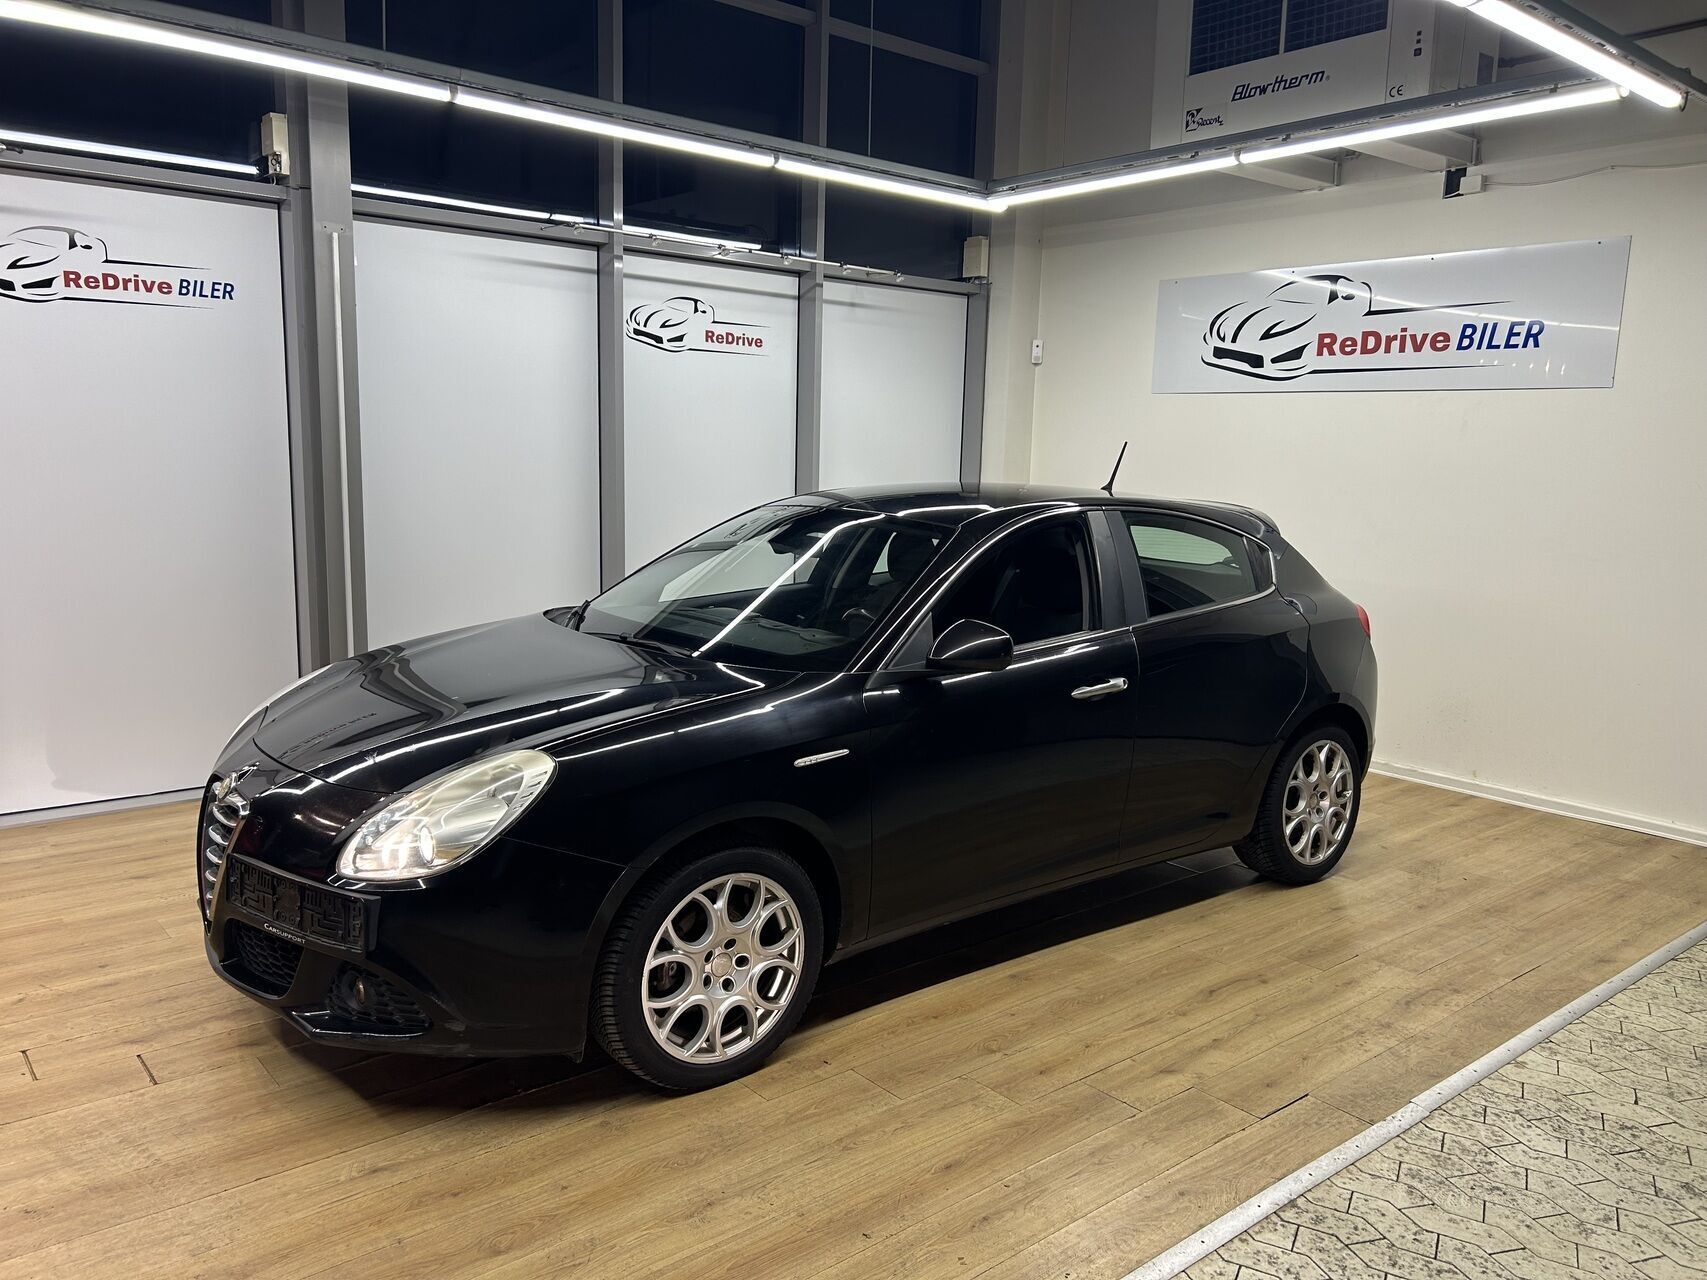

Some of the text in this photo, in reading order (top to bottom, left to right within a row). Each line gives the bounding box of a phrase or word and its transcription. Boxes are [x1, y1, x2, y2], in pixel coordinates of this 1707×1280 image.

[1231, 70, 1326, 103] Blowtherm
[63, 270, 235, 301] ReDrive BILER
[704, 329, 763, 348] ReDrive
[1316, 319, 1545, 357] ReDrive BILER
